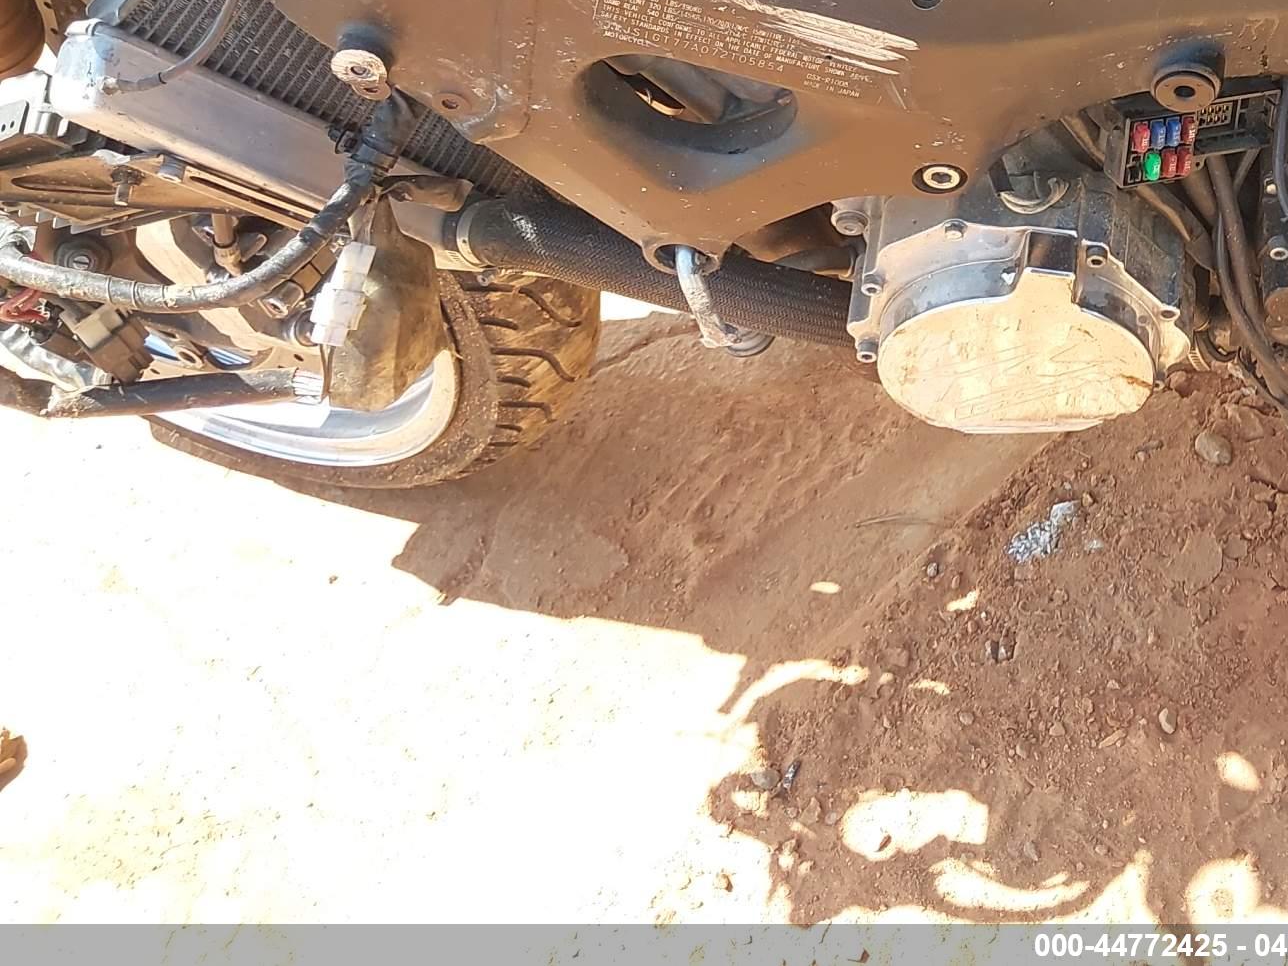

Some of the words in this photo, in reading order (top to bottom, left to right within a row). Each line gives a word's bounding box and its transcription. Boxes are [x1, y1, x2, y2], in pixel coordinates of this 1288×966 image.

[598, 10, 628, 23] SAFETY
[629, 18, 670, 34] STANDARDS
[673, 29, 682, 37] IN
[685, 32, 711, 45] EFFECT
[714, 40, 724, 48] ON
[727, 43, 740, 52] THE
[742, 46, 761, 57] DATE
[762, 51, 772, 60] OF
[775, 54, 820, 71] MANUFACTURE
[601, 3, 620, 13] THIS
[622, 9, 654, 23] VEHICLE
[657, 18, 692, 33] CONFORMS
[696, 28, 705, 36] TO
[707, 31, 721, 40] ALL
[724, 35, 767, 51] APPLICABLE
[769, 46, 799, 59] FEDERAL
[825, 84, 835, 92] IN
[837, 87, 860, 98] JAPAN
